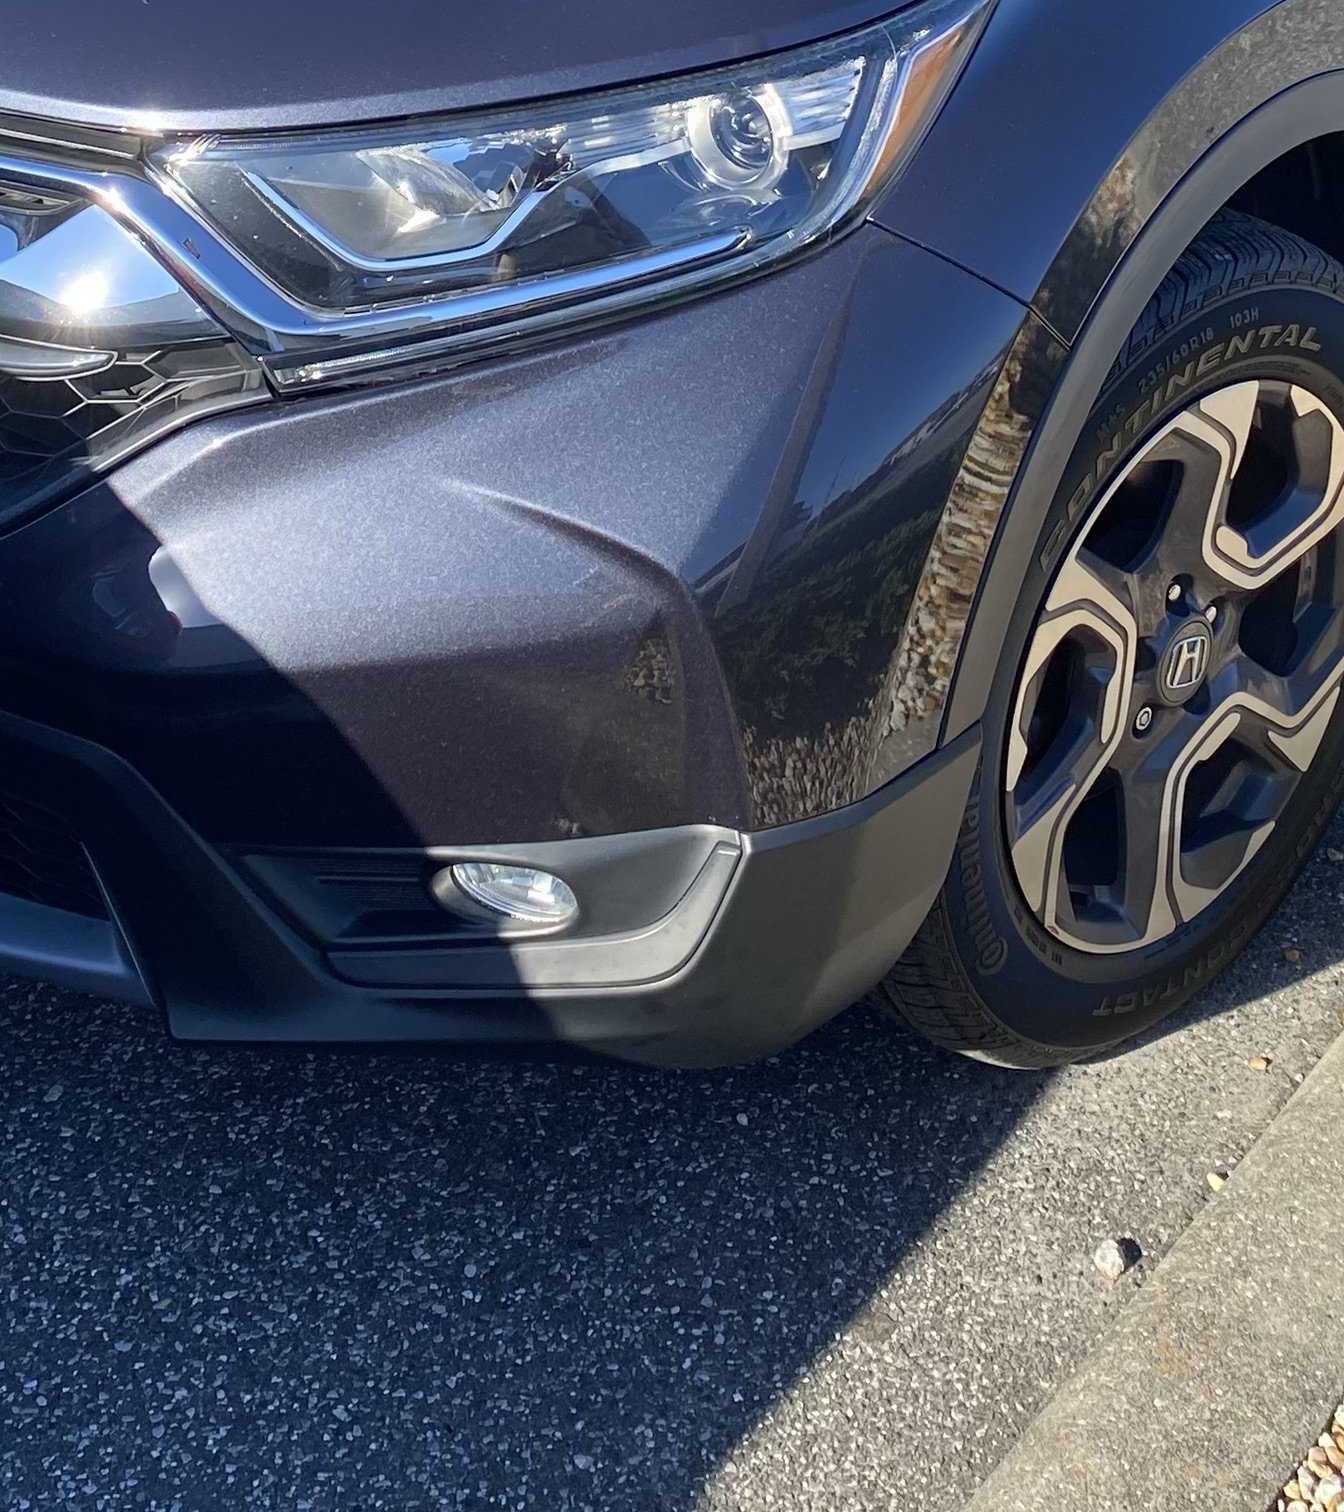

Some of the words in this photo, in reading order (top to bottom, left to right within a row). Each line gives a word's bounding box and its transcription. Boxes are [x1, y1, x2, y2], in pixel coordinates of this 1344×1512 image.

[1229, 306, 1260, 329] 103H
[1137, 326, 1215, 395] 235/60R18
[1039, 324, 1322, 574] CONTINENTAL
